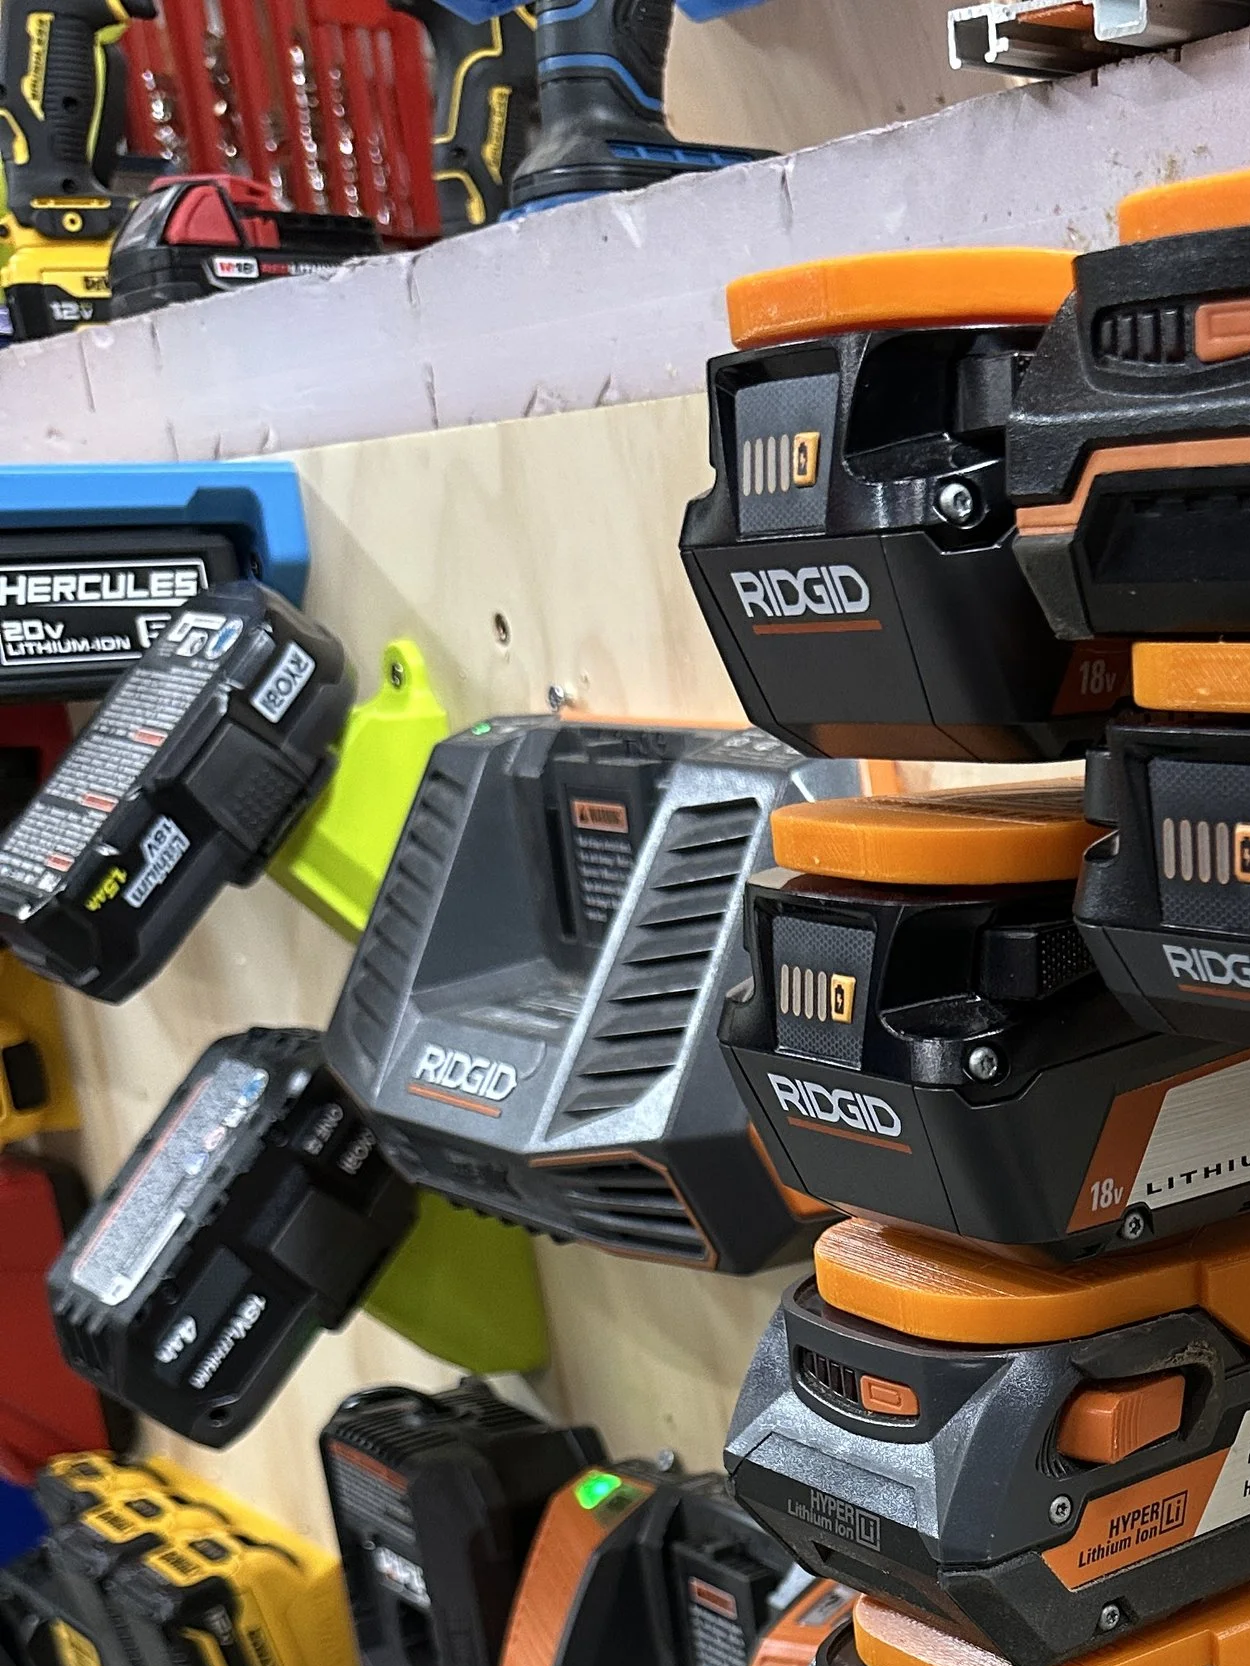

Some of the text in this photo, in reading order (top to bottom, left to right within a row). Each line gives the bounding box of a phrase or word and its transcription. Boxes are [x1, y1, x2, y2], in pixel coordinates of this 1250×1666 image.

[0, 570, 198, 606] HERCULES
[730, 565, 870, 619] RIDGID
[6, 635, 132, 656] LITHIUM-ION
[264, 653, 309, 713] RYOBI
[148, 819, 174, 852] 18V
[131, 834, 187, 902] Lithium
[415, 1044, 518, 1102] RIDGID
[767, 1072, 902, 1137] RIDGID
[786, 1498, 854, 1542] Lithium Ion
[809, 1488, 855, 1526] HYPER
[1108, 1500, 1160, 1539] HYPER
[1077, 1526, 1159, 1569] Lithium Ion
